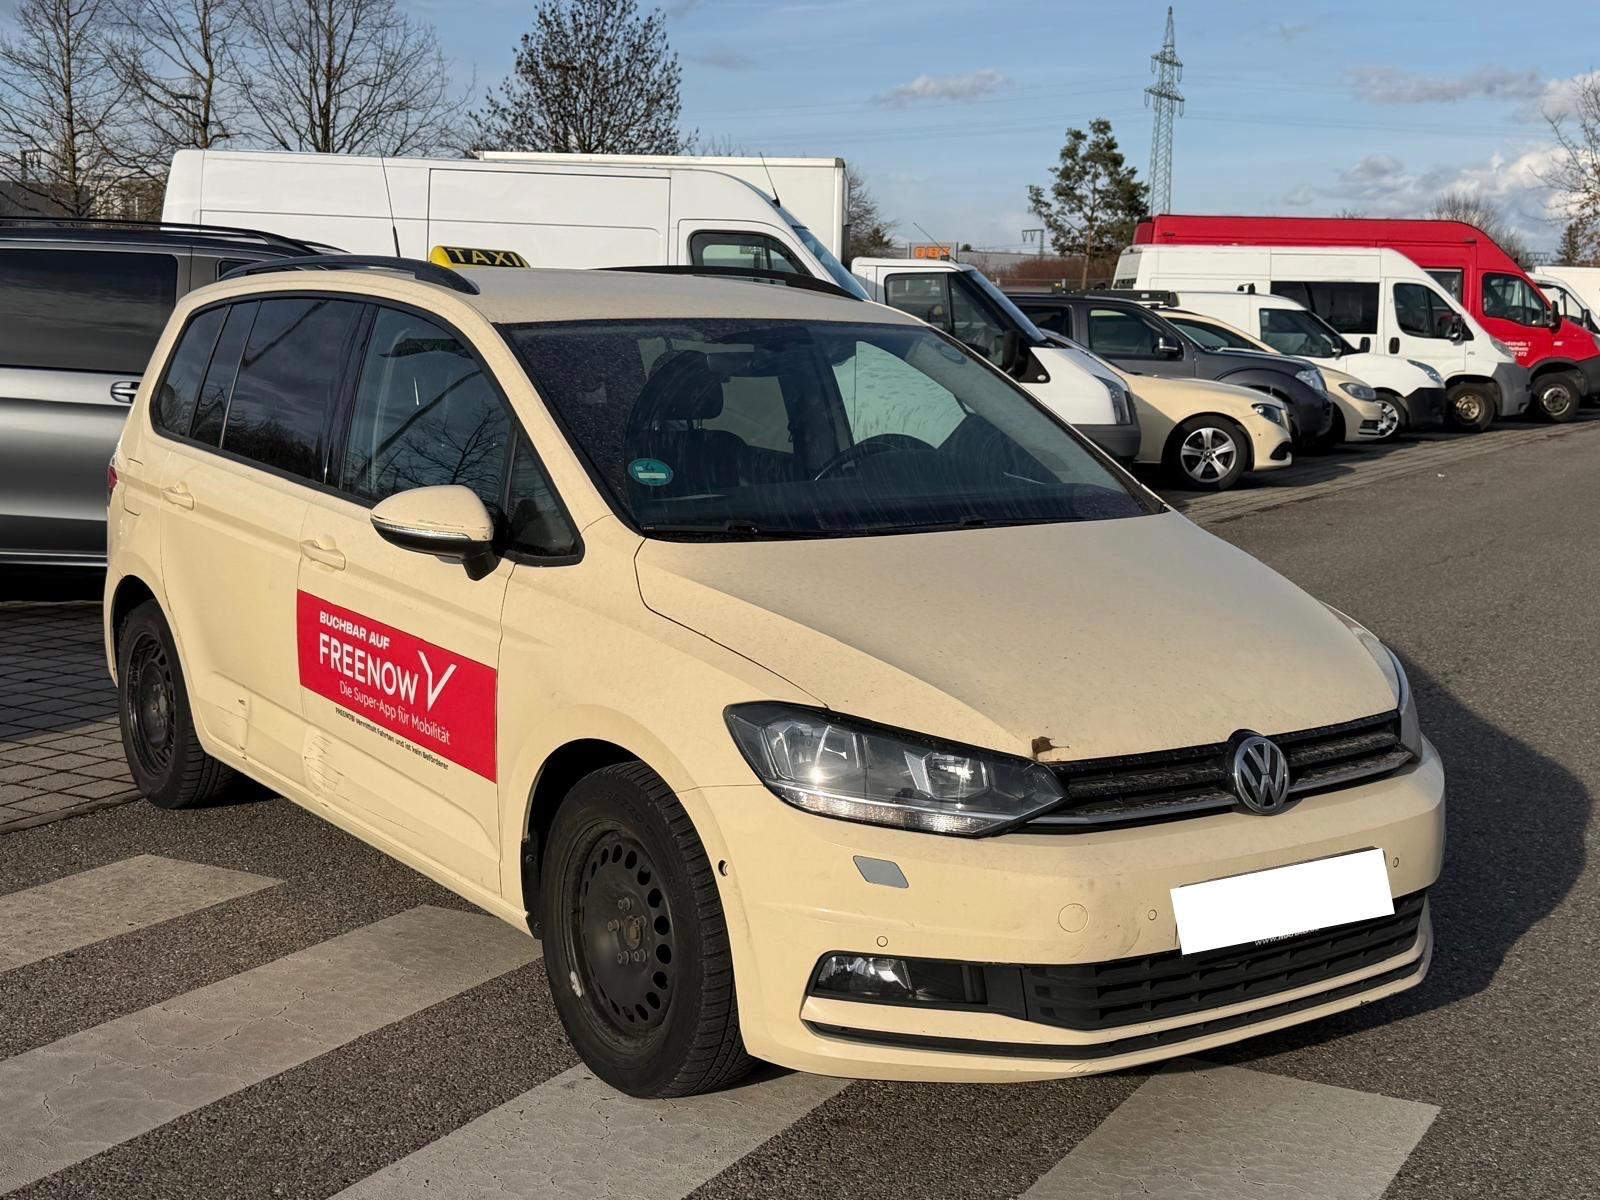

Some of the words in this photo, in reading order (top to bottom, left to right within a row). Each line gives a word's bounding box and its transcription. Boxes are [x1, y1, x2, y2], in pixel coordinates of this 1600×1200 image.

[447, 248, 521, 267] TAXI
[320, 611, 367, 641] BUCHBAR
[369, 631, 390, 650] AUF
[320, 632, 419, 704] FREENOW
[340, 680, 353, 698] Die
[354, 687, 397, 721] Super-App
[398, 705, 410, 726] für
[411, 712, 450, 745] Mobilität
